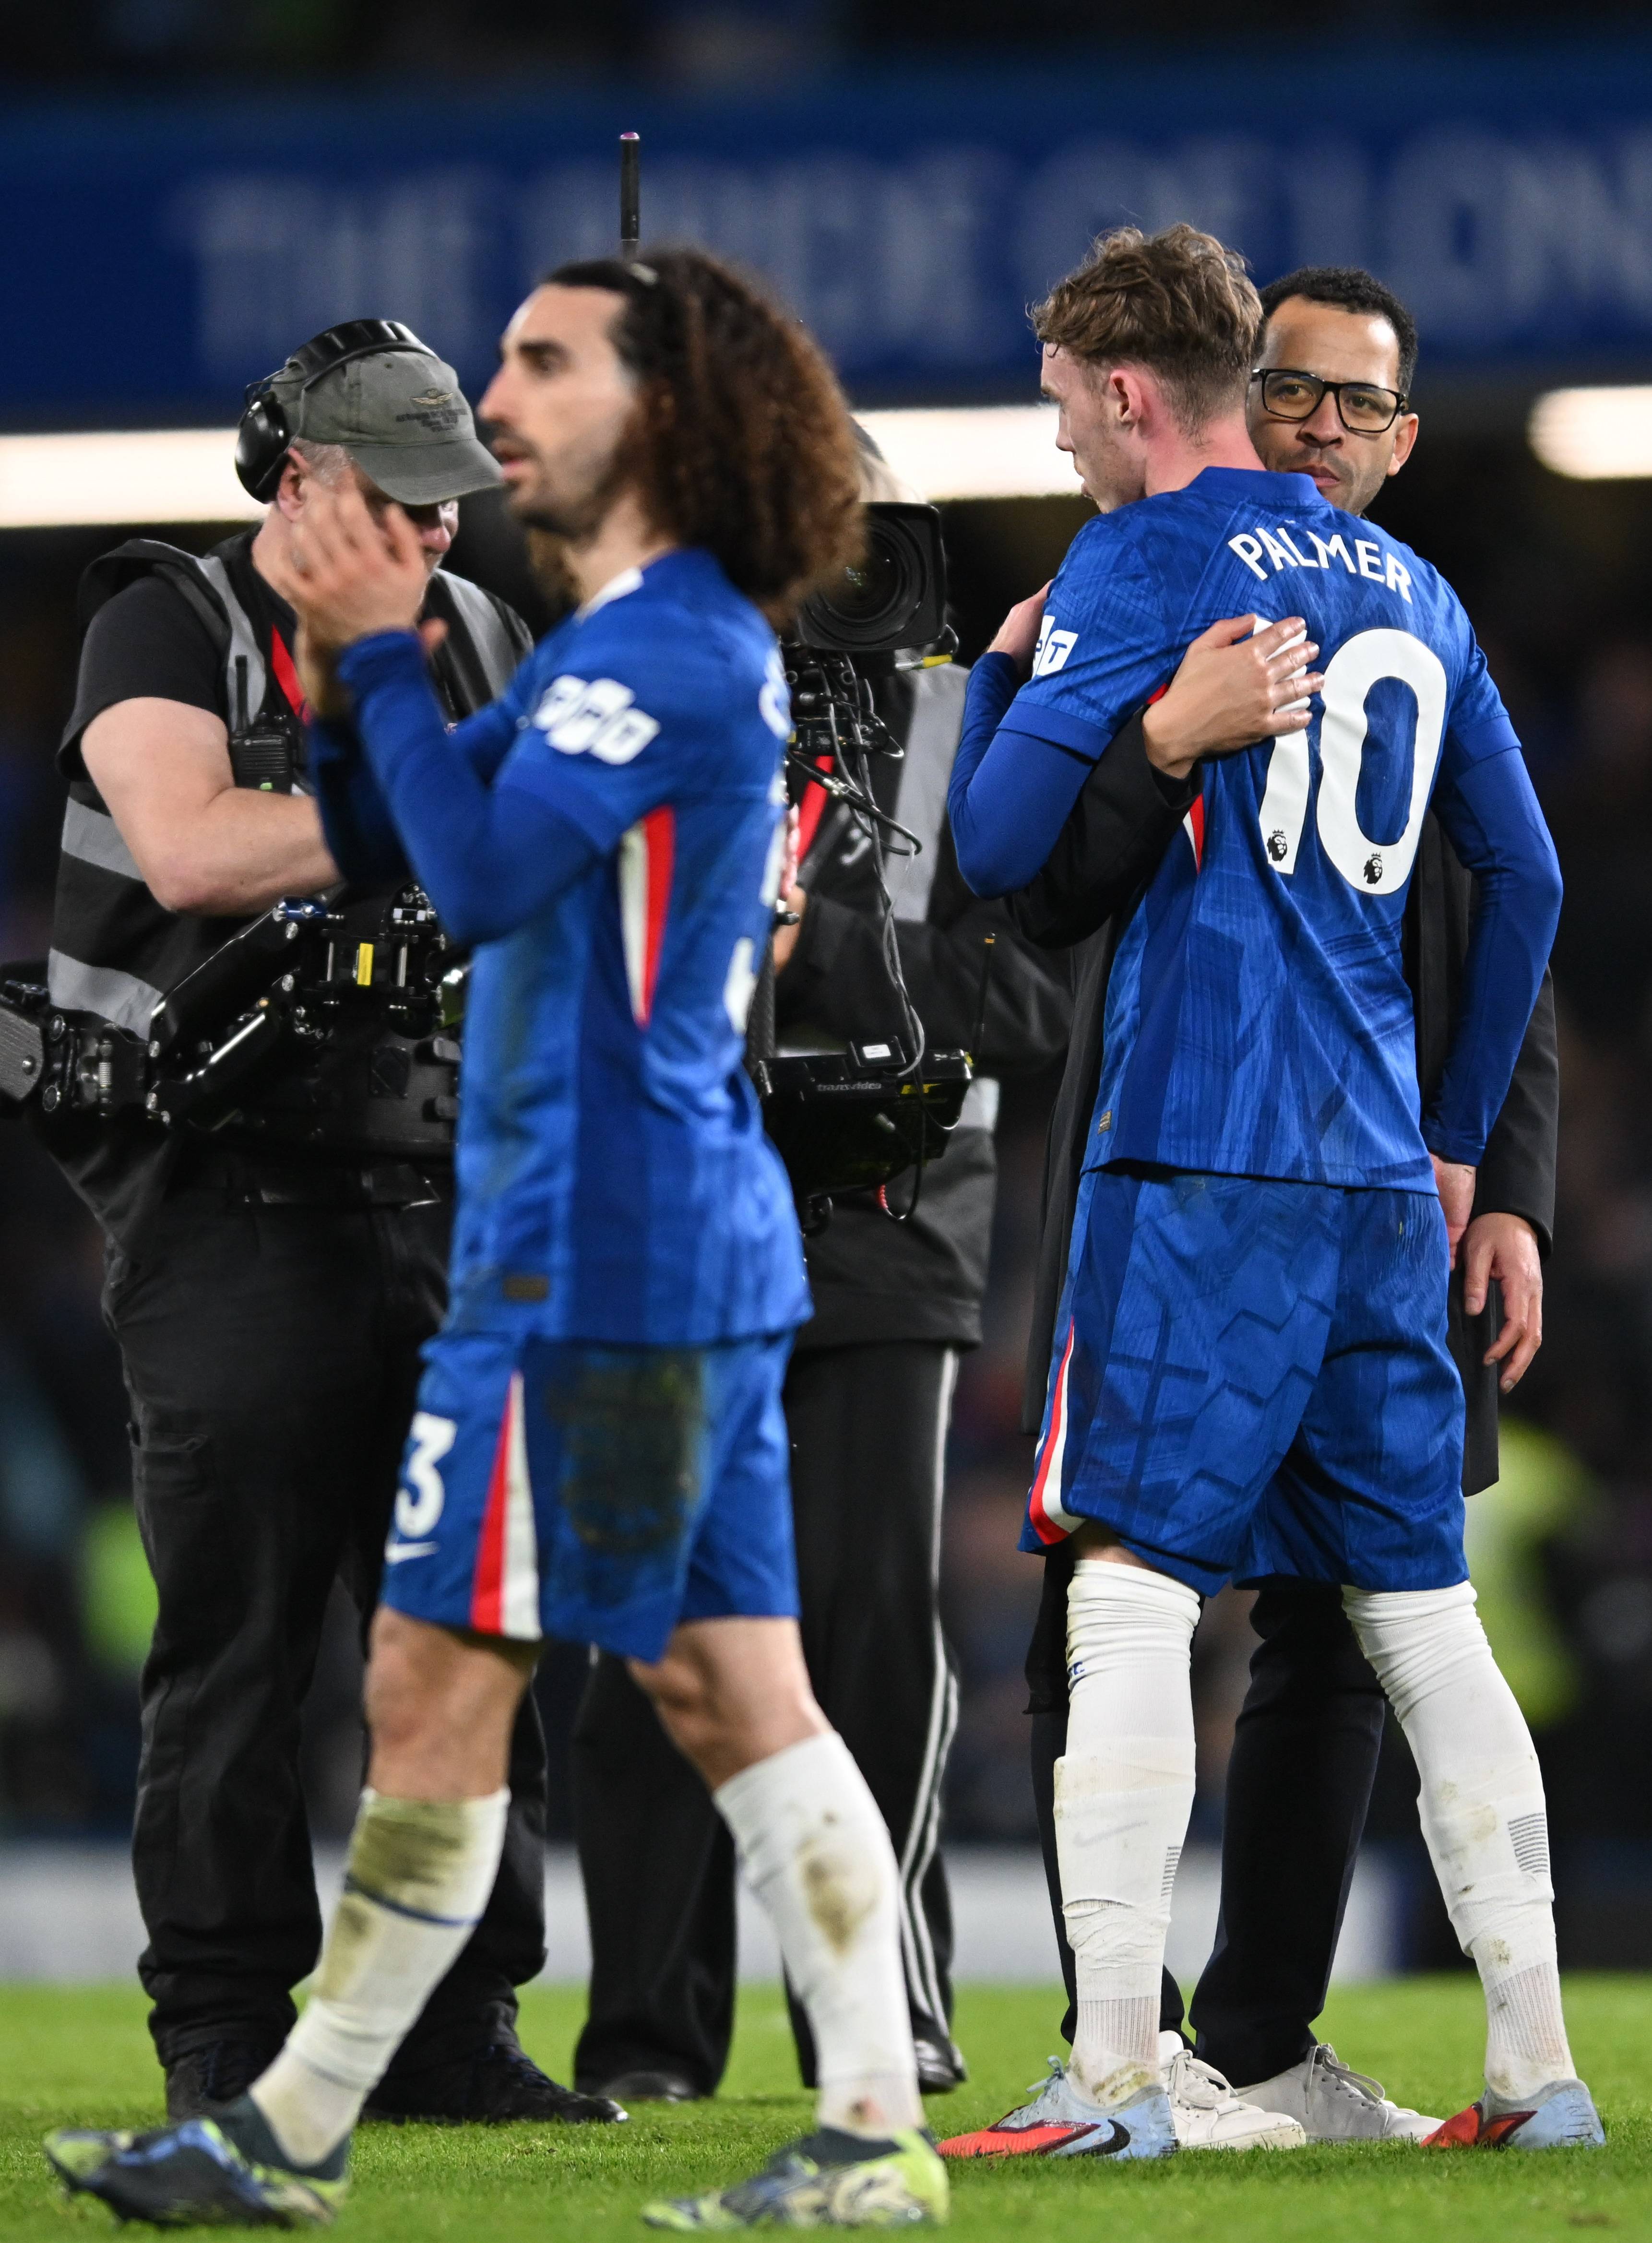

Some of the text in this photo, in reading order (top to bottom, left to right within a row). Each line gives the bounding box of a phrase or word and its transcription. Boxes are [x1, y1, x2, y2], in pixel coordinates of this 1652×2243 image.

[1227, 527, 1413, 605] PALMER
[1253, 617, 1447, 896] 10
[394, 1411, 457, 1539] 3
